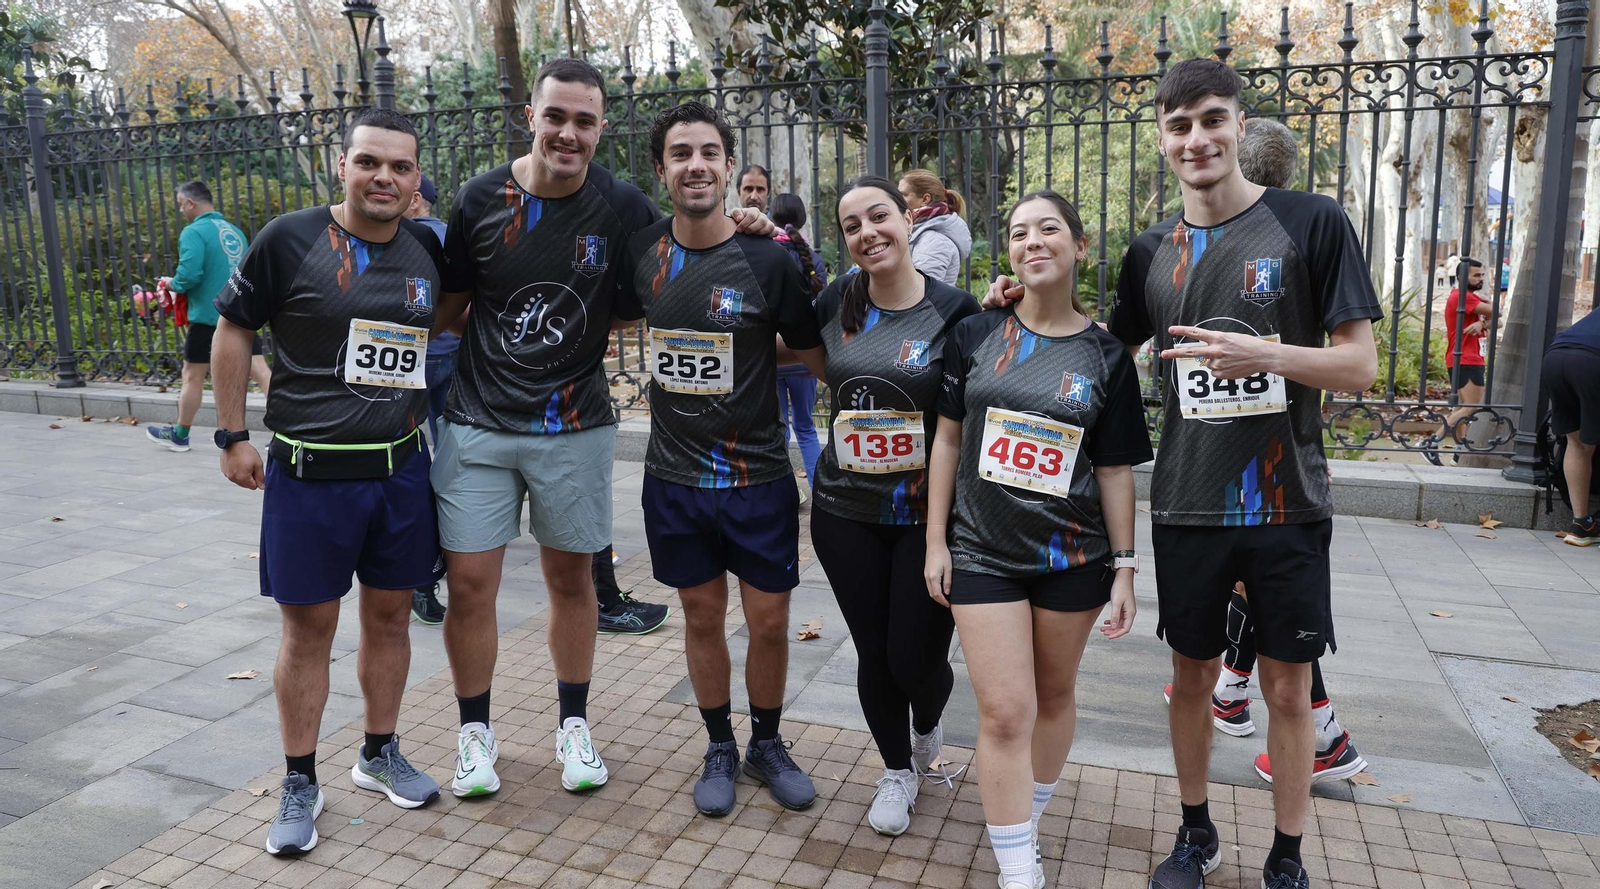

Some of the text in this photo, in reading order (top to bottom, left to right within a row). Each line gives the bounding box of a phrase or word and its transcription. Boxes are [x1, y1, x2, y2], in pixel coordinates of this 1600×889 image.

[355, 344, 418, 373] 309
[657, 351, 722, 380] 252
[1187, 370, 1270, 398] 348
[1060, 397, 1088, 409] TRAINING
[1243, 394, 1261, 402] ENRIQUE
[848, 417, 877, 428] CARRERA
[879, 416, 907, 427] NAVIDAD
[1001, 419, 1034, 435] CARRERA
[1034, 427, 1064, 441] NAVIDAD
[843, 433, 914, 458] 138
[987, 436, 1064, 476] 463
